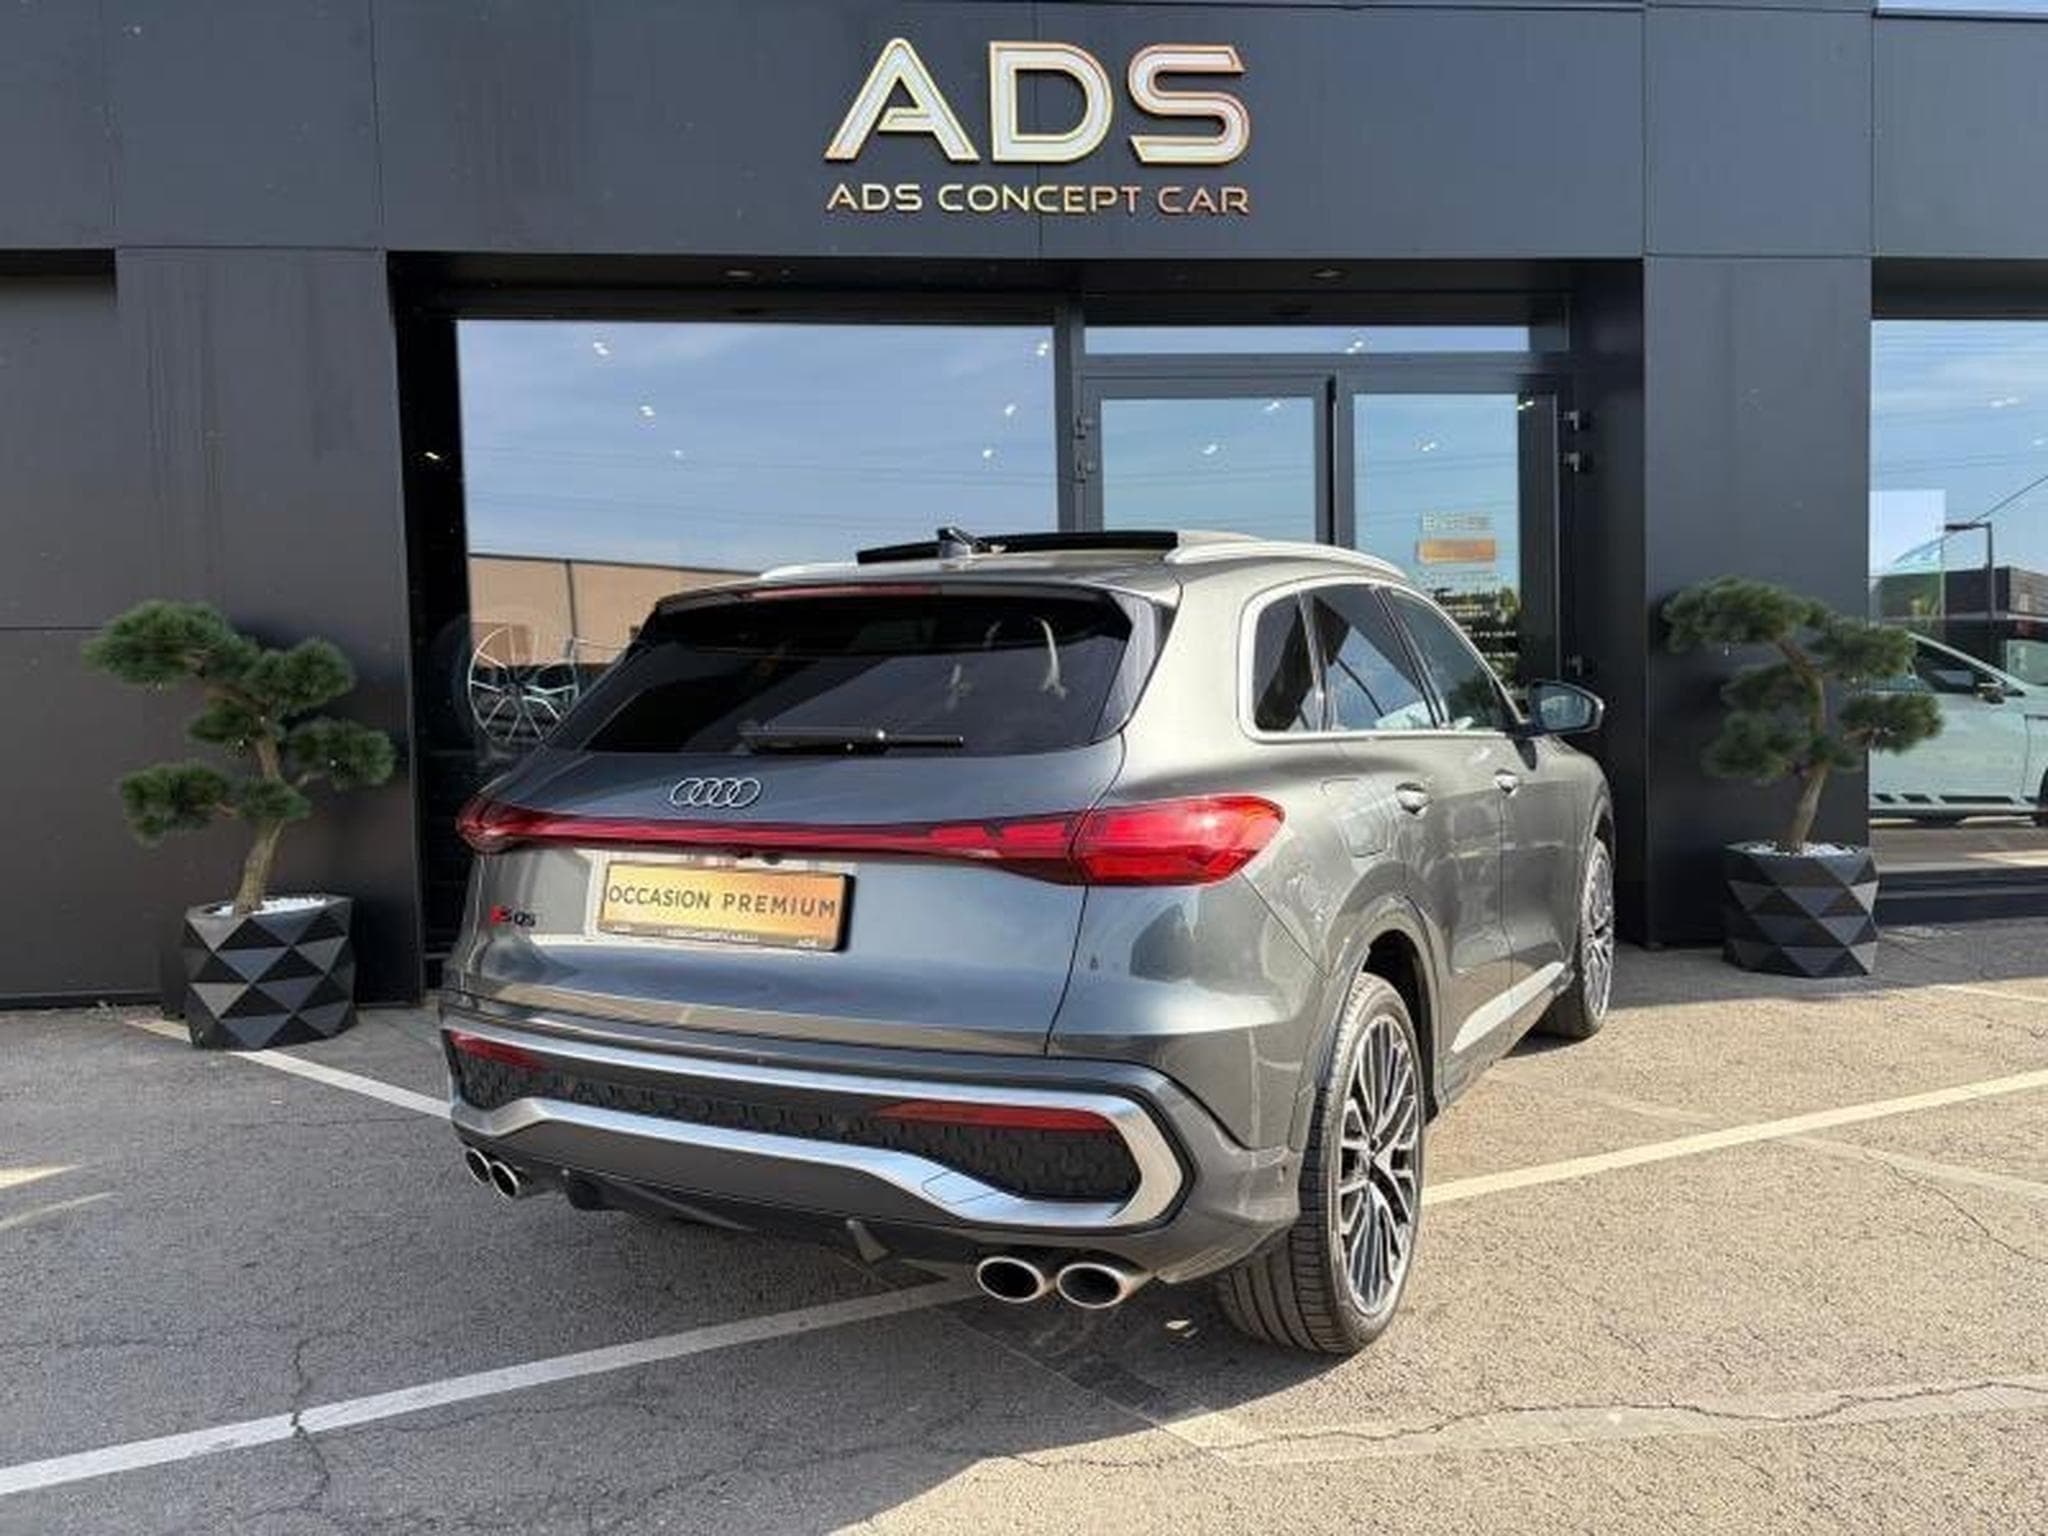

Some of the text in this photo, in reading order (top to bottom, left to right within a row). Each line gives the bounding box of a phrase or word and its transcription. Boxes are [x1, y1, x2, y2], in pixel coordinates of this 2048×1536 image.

[823, 37, 1251, 164] ADS
[826, 183, 1249, 214] ADS CONCEPT CAR
[608, 885, 836, 918] OCCASION PREMIUM
